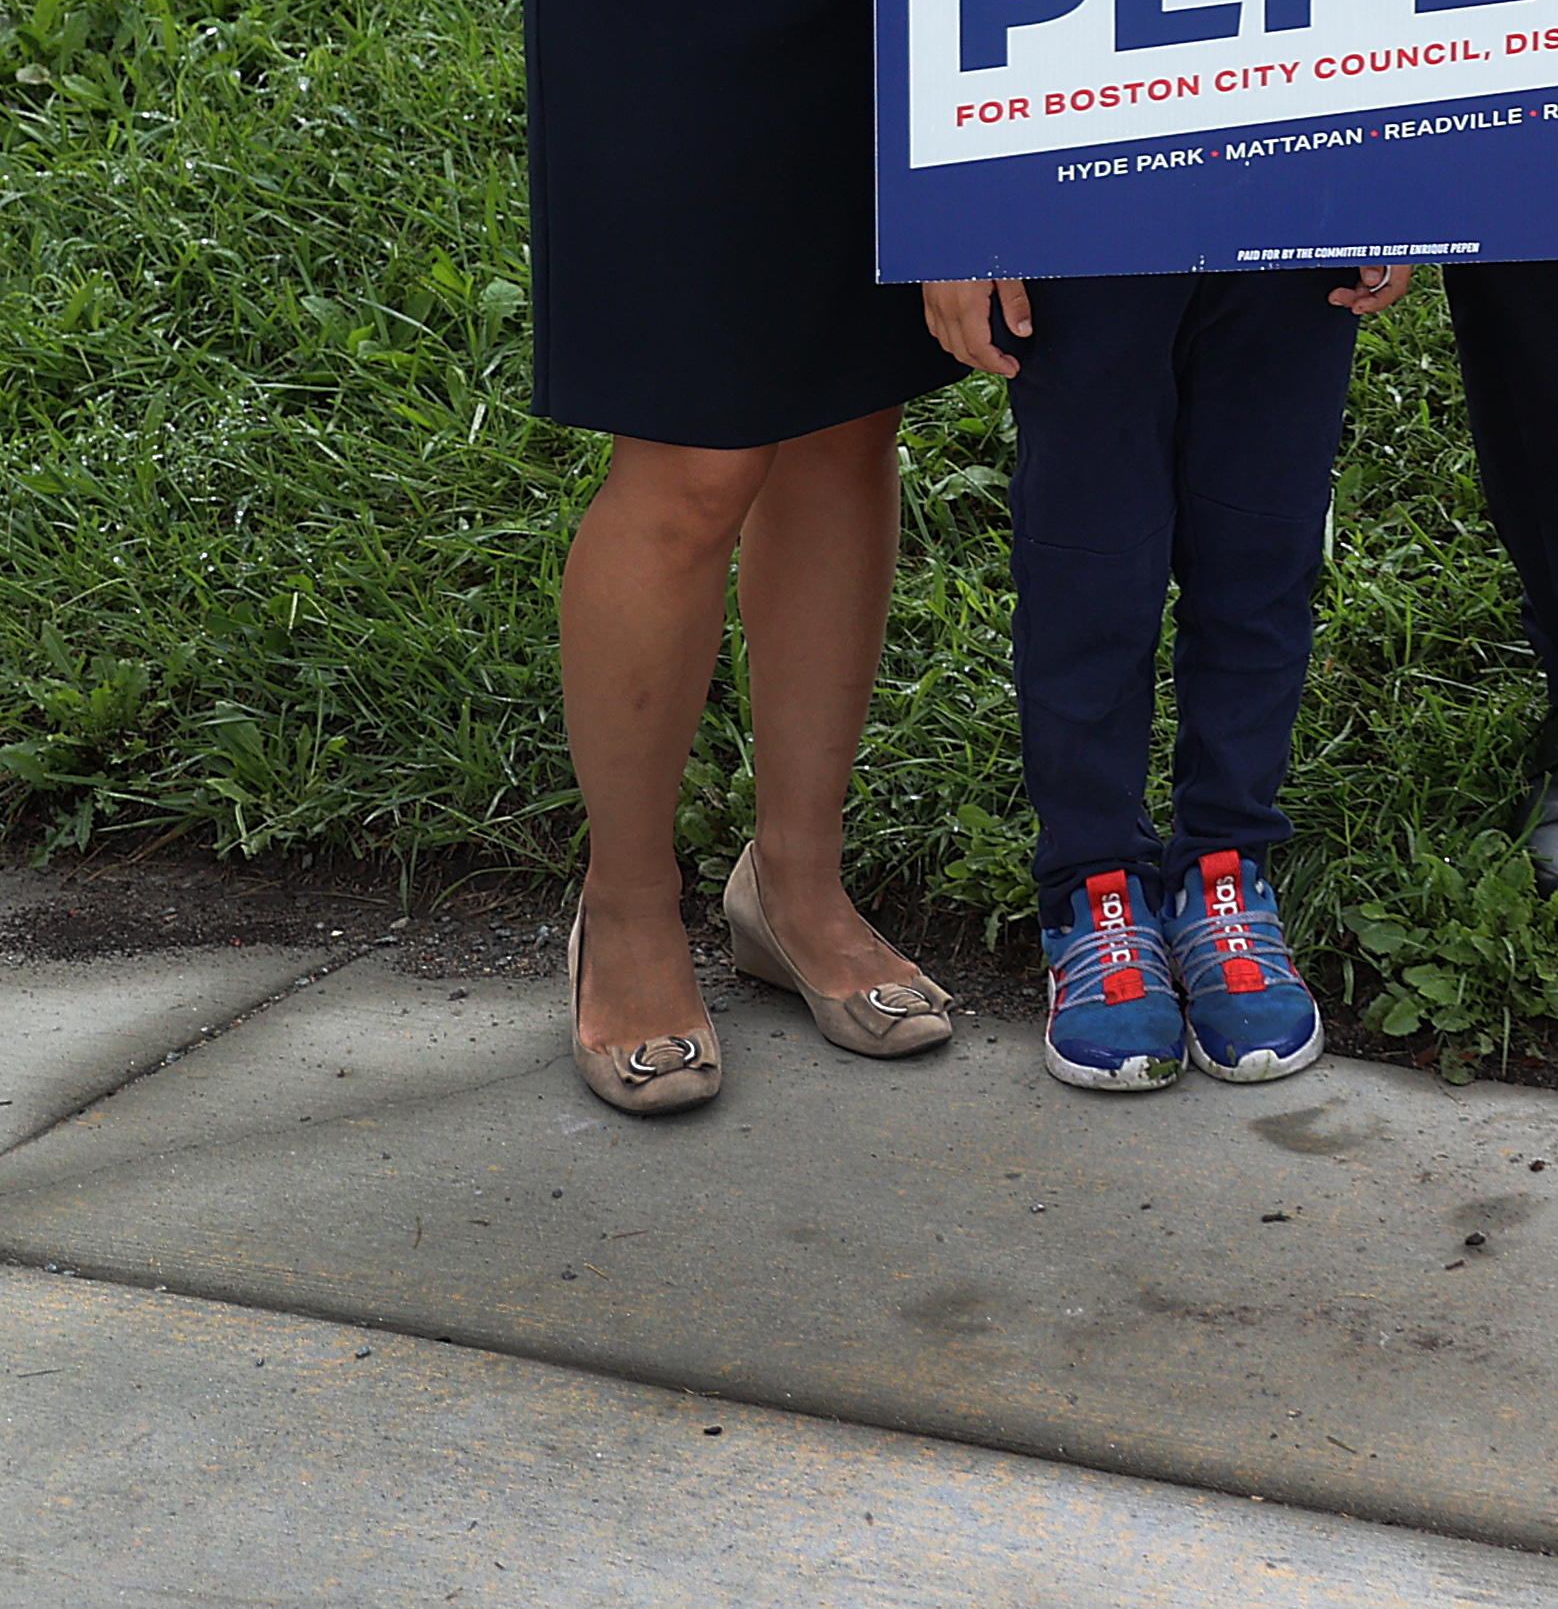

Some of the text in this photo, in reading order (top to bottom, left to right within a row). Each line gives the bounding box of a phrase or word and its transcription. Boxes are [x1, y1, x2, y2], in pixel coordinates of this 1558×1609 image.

[956, 97, 1030, 127] FOR
[1045, 75, 1200, 116] BOSTON
[1214, 61, 1300, 92] CITY
[1314, 40, 1491, 79] COUNCIL,
[1057, 157, 1129, 182] HYDE
[1136, 147, 1204, 172] PARK
[1225, 127, 1363, 161] MATTAPAN
[1384, 107, 1523, 140] READVILLE
[1237, 242, 1480, 261] PAID FOR BY THE COMMITTEE TO ELECT ENRIQUE PEPEN
[1099, 892, 1132, 963] adas
[1212, 875, 1247, 953] adas
